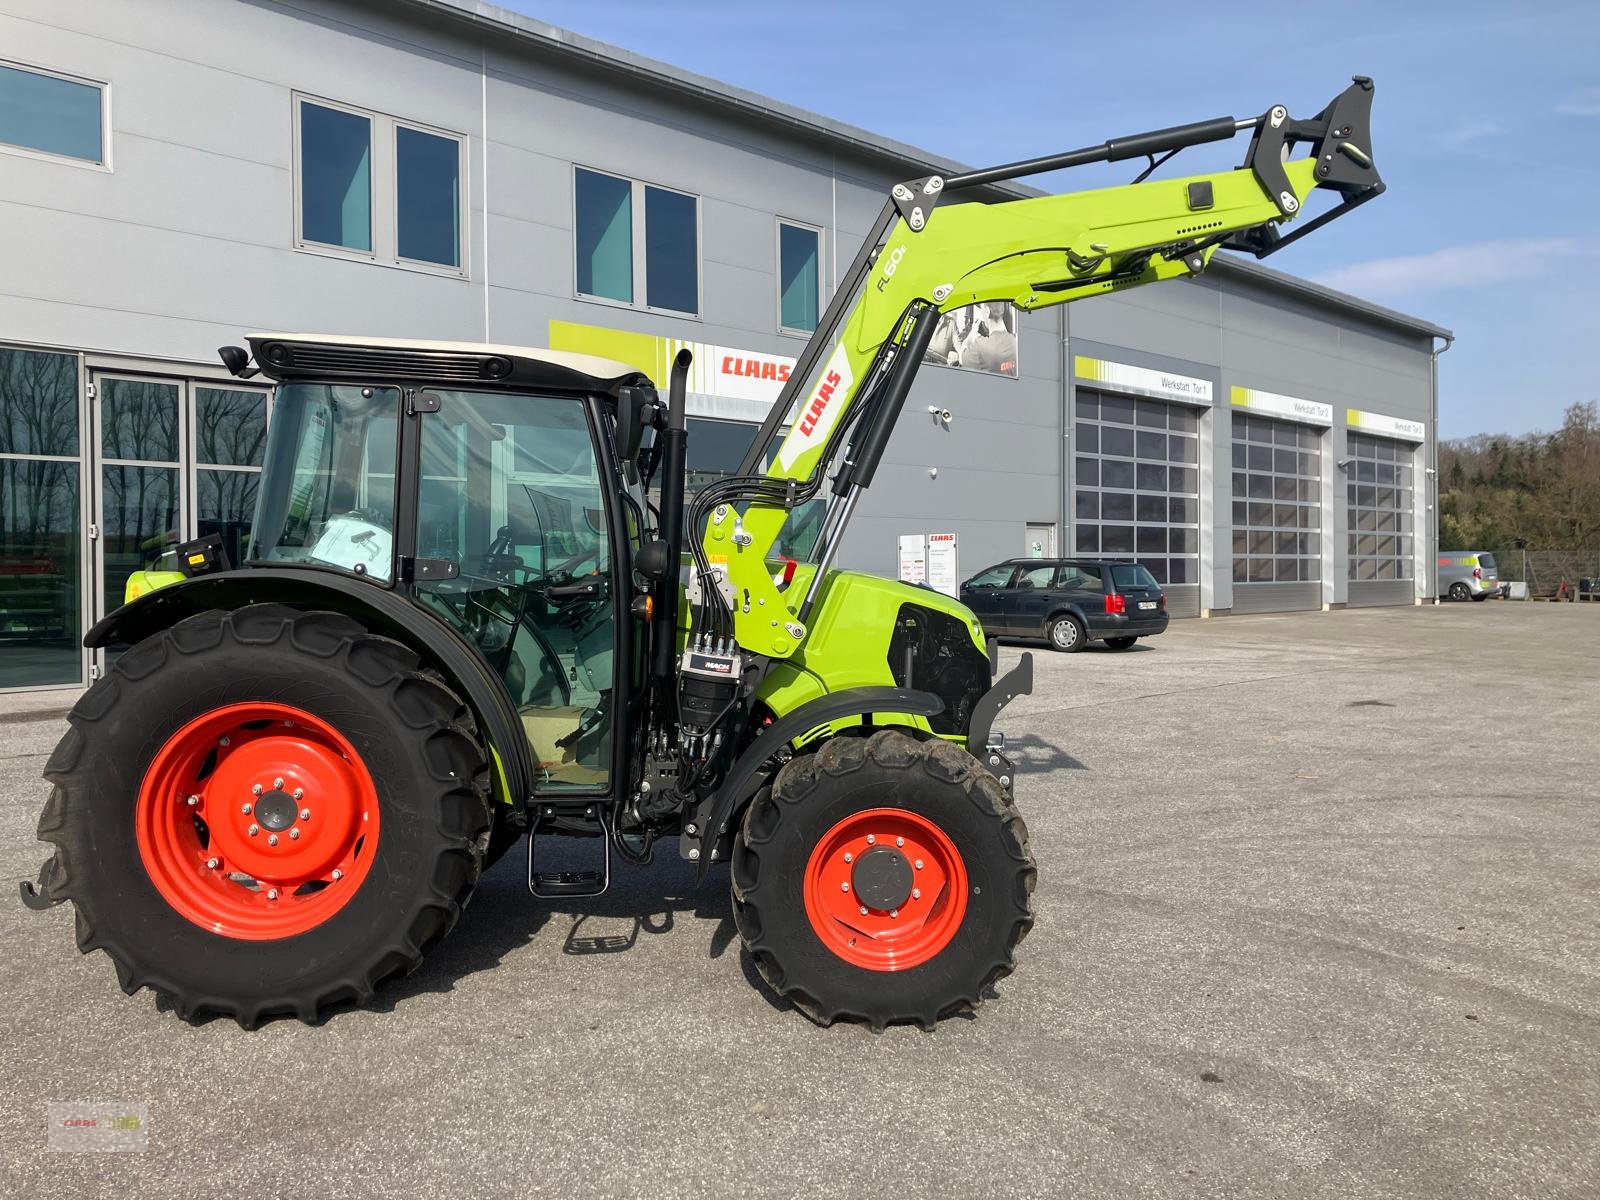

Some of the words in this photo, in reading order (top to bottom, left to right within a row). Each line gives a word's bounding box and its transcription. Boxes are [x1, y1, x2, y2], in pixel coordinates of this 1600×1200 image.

[721, 356, 791, 382] CLAAS
[1161, 377, 1190, 392] Werkstatt
[1193, 383, 1202, 394] Tor
[799, 369, 842, 438] CLAAS
